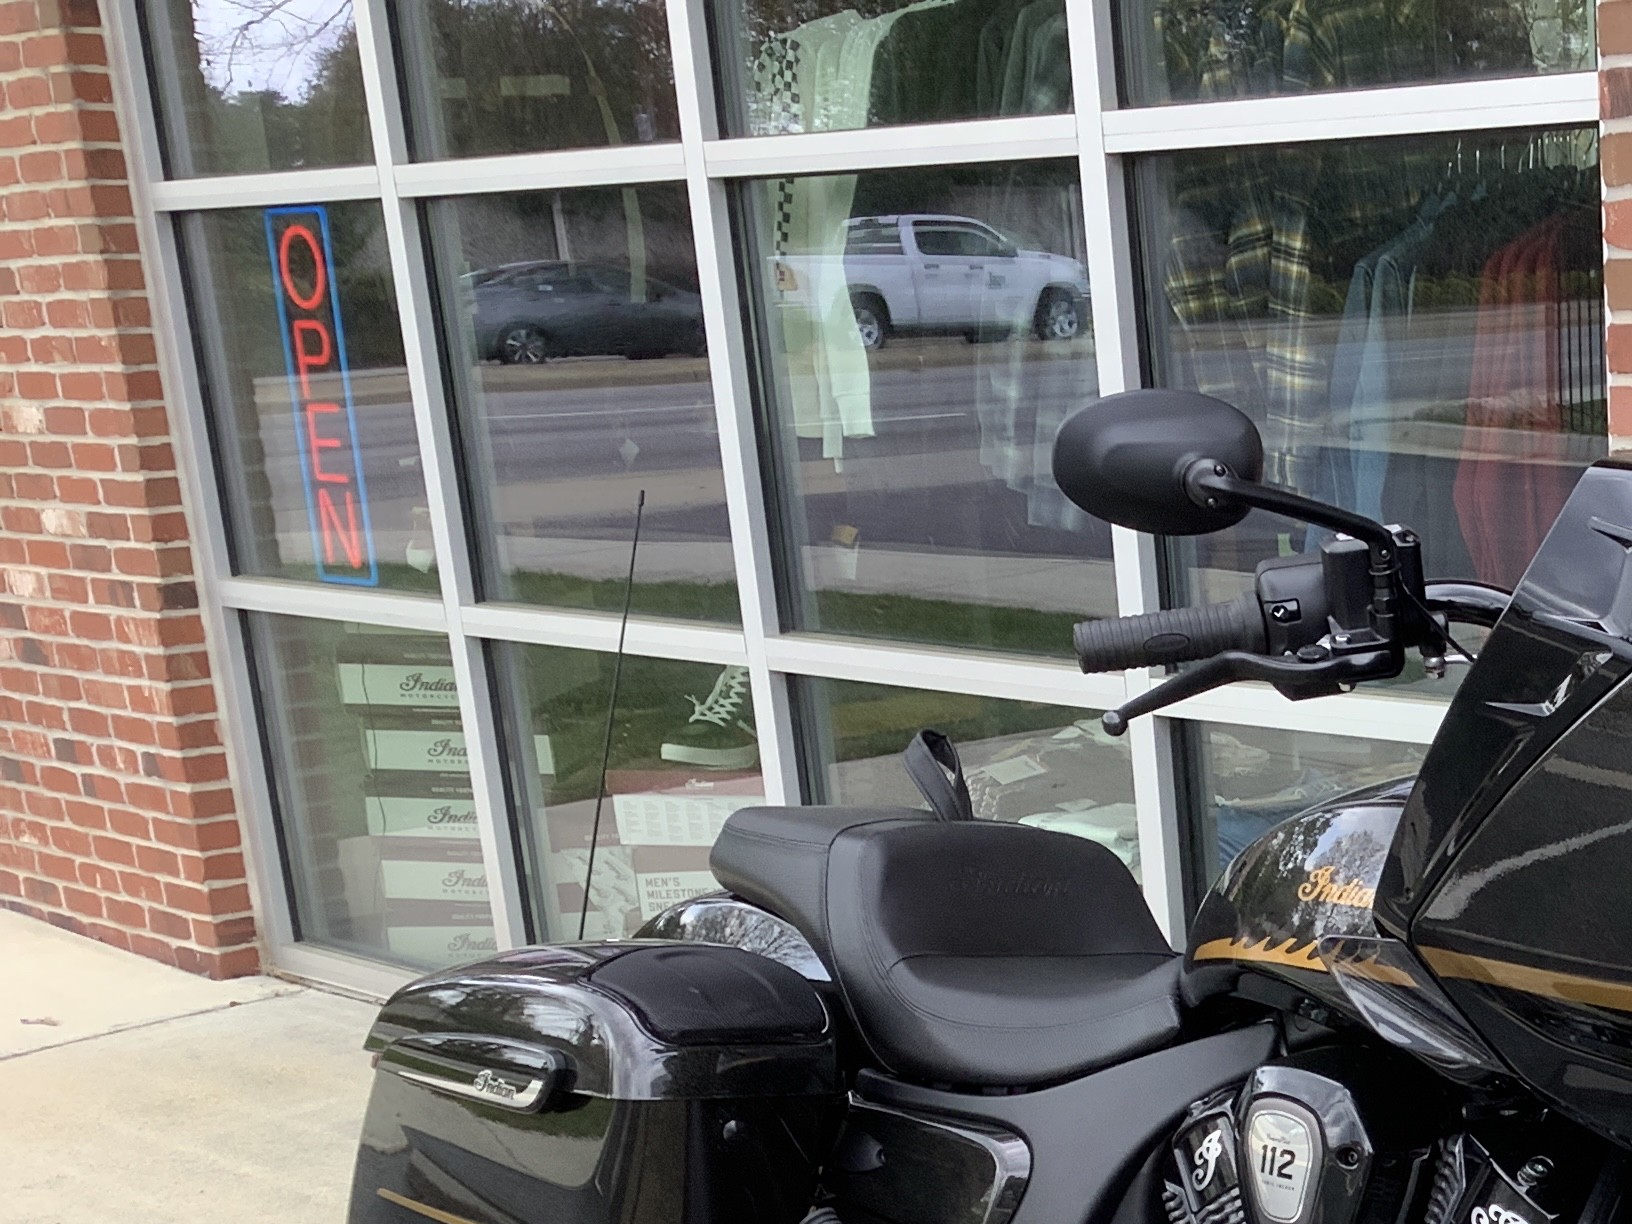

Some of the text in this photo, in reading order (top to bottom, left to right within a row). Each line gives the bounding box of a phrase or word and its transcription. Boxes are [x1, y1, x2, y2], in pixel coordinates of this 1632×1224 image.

[279, 224, 361, 569] OPEN
[645, 877, 680, 888] MEN'S
[474, 1069, 517, 1100] Indian
[1261, 1144, 1296, 1180] 112
